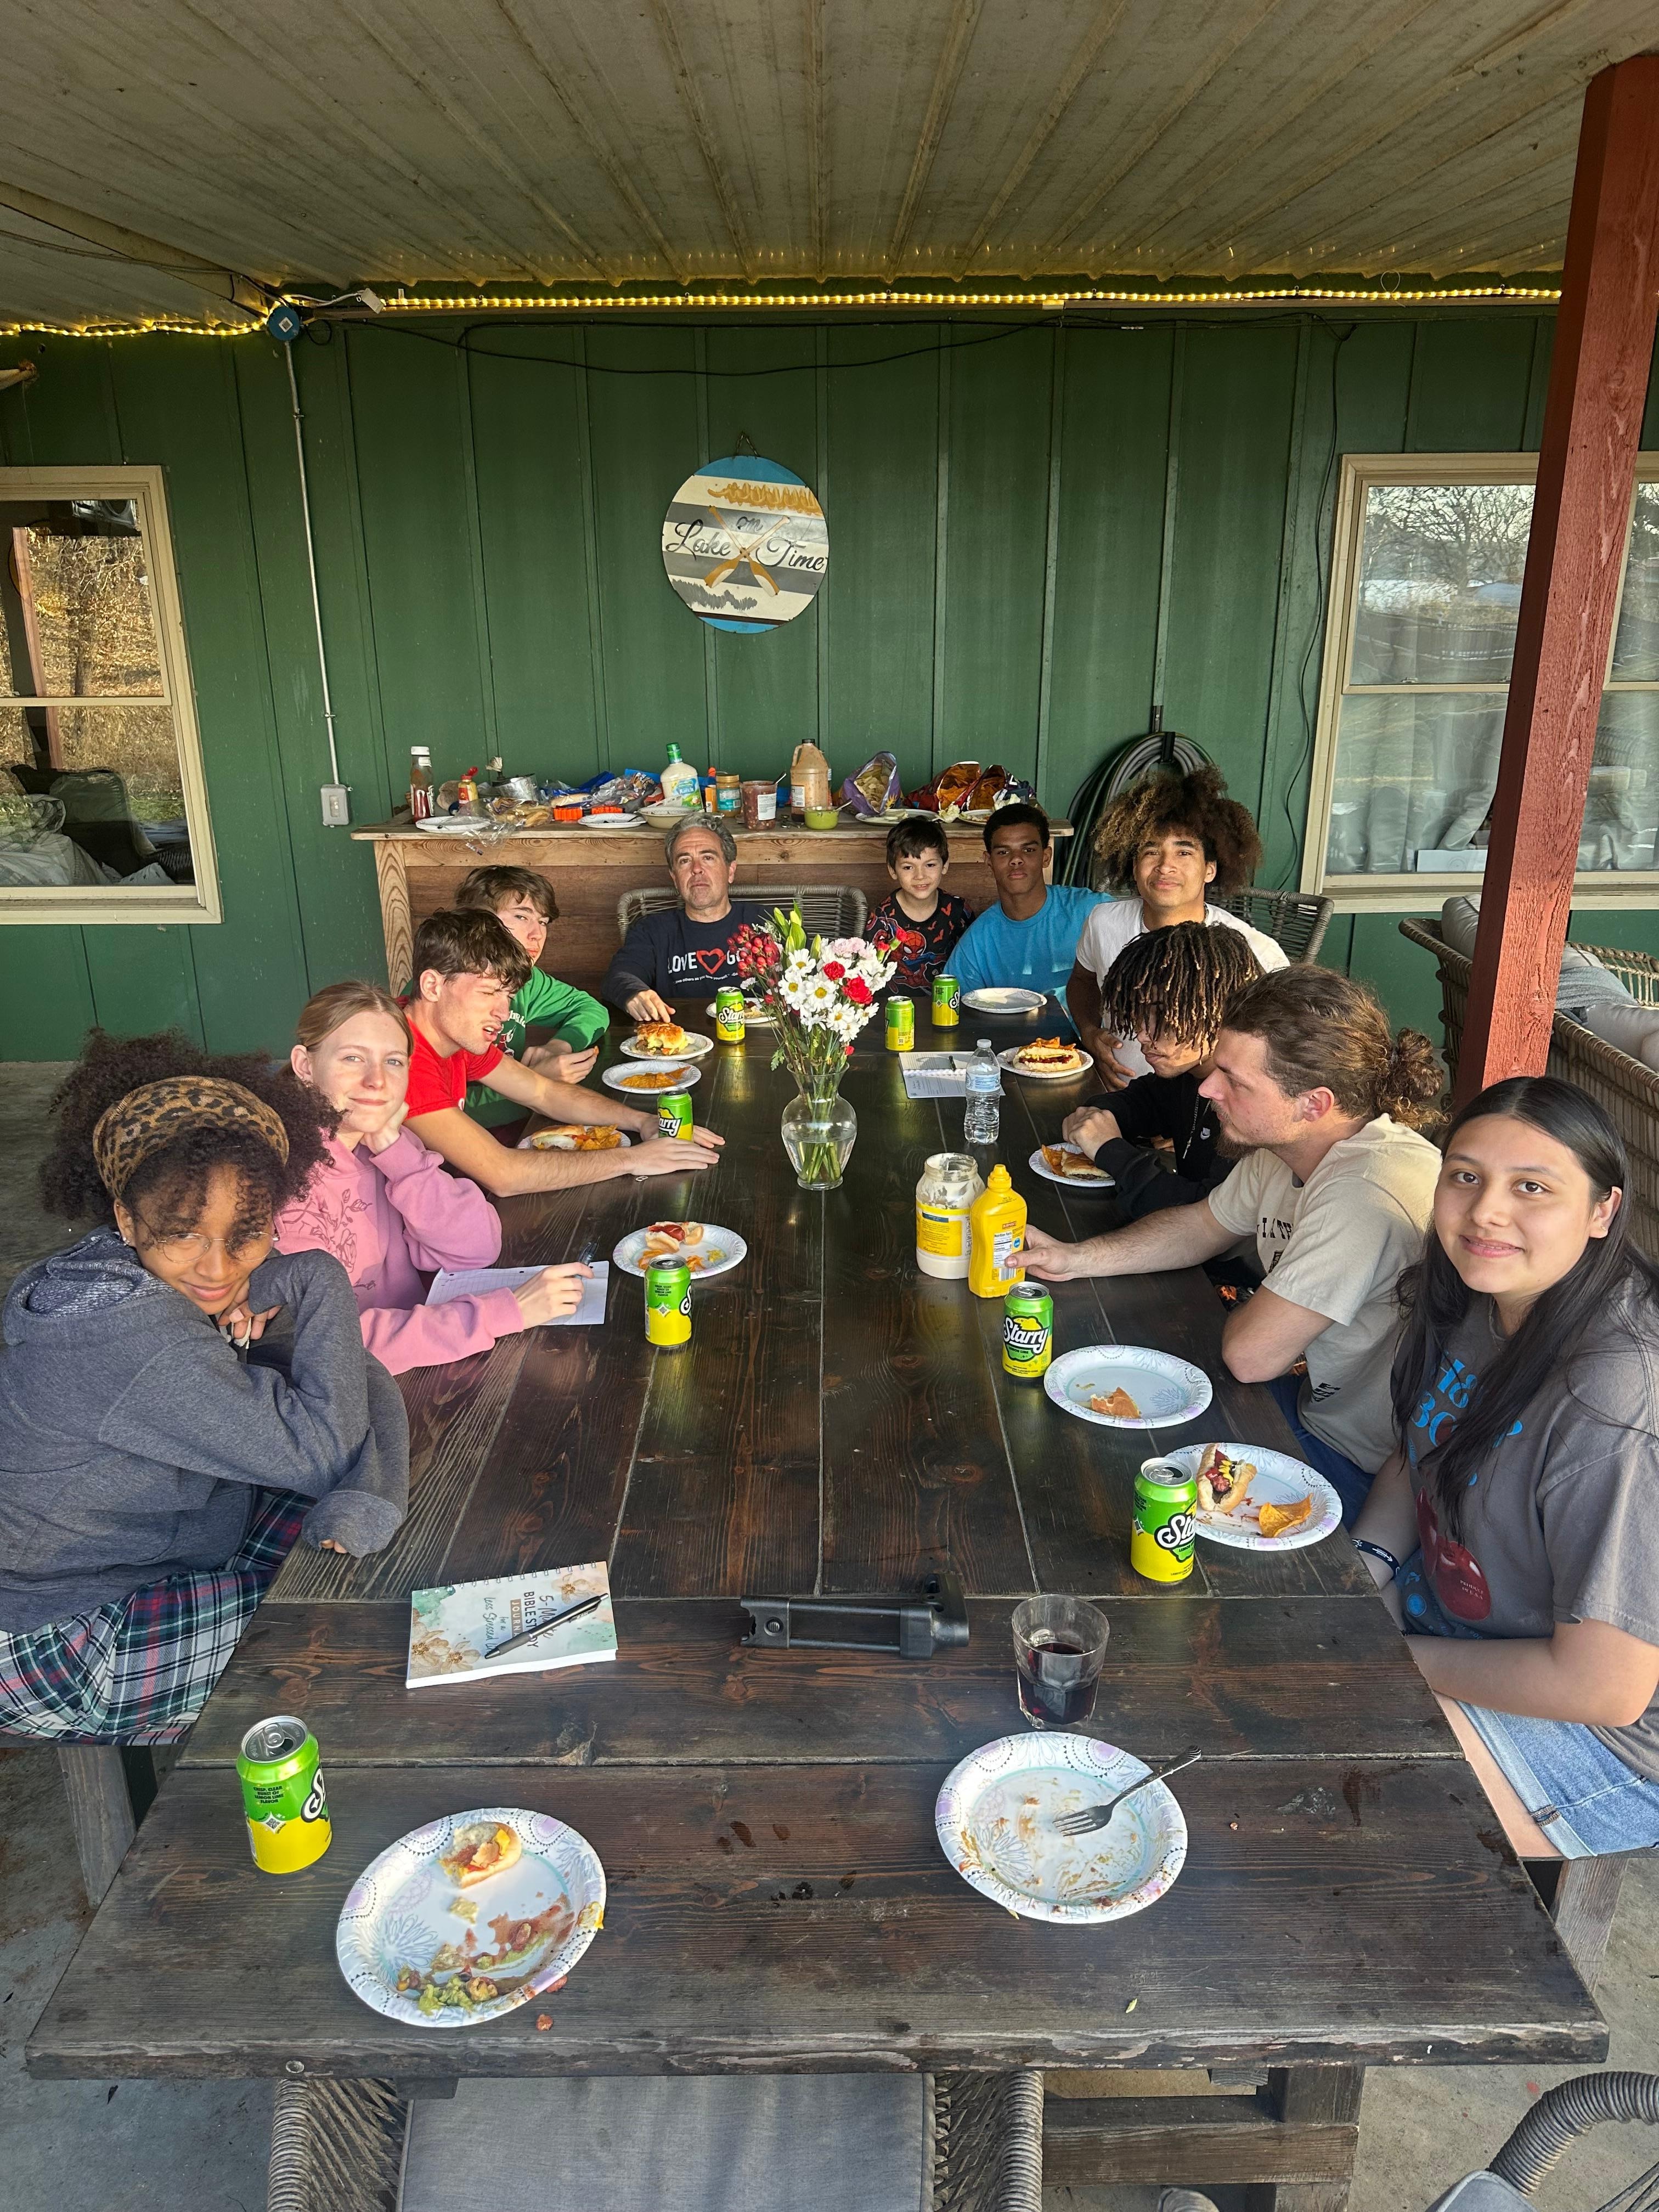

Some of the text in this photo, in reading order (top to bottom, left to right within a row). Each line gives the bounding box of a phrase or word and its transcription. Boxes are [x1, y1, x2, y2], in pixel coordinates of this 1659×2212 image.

[665, 519, 824, 571] Lake Time
[668, 952, 697, 974] LOVE
[659, 1118, 681, 1137] arry
[1004, 1317, 1049, 1354] Starry
[484, 1597, 496, 1610] Less
[483, 1612, 499, 1641] Stressed
[524, 1591, 539, 1647] BIBLE STDY
